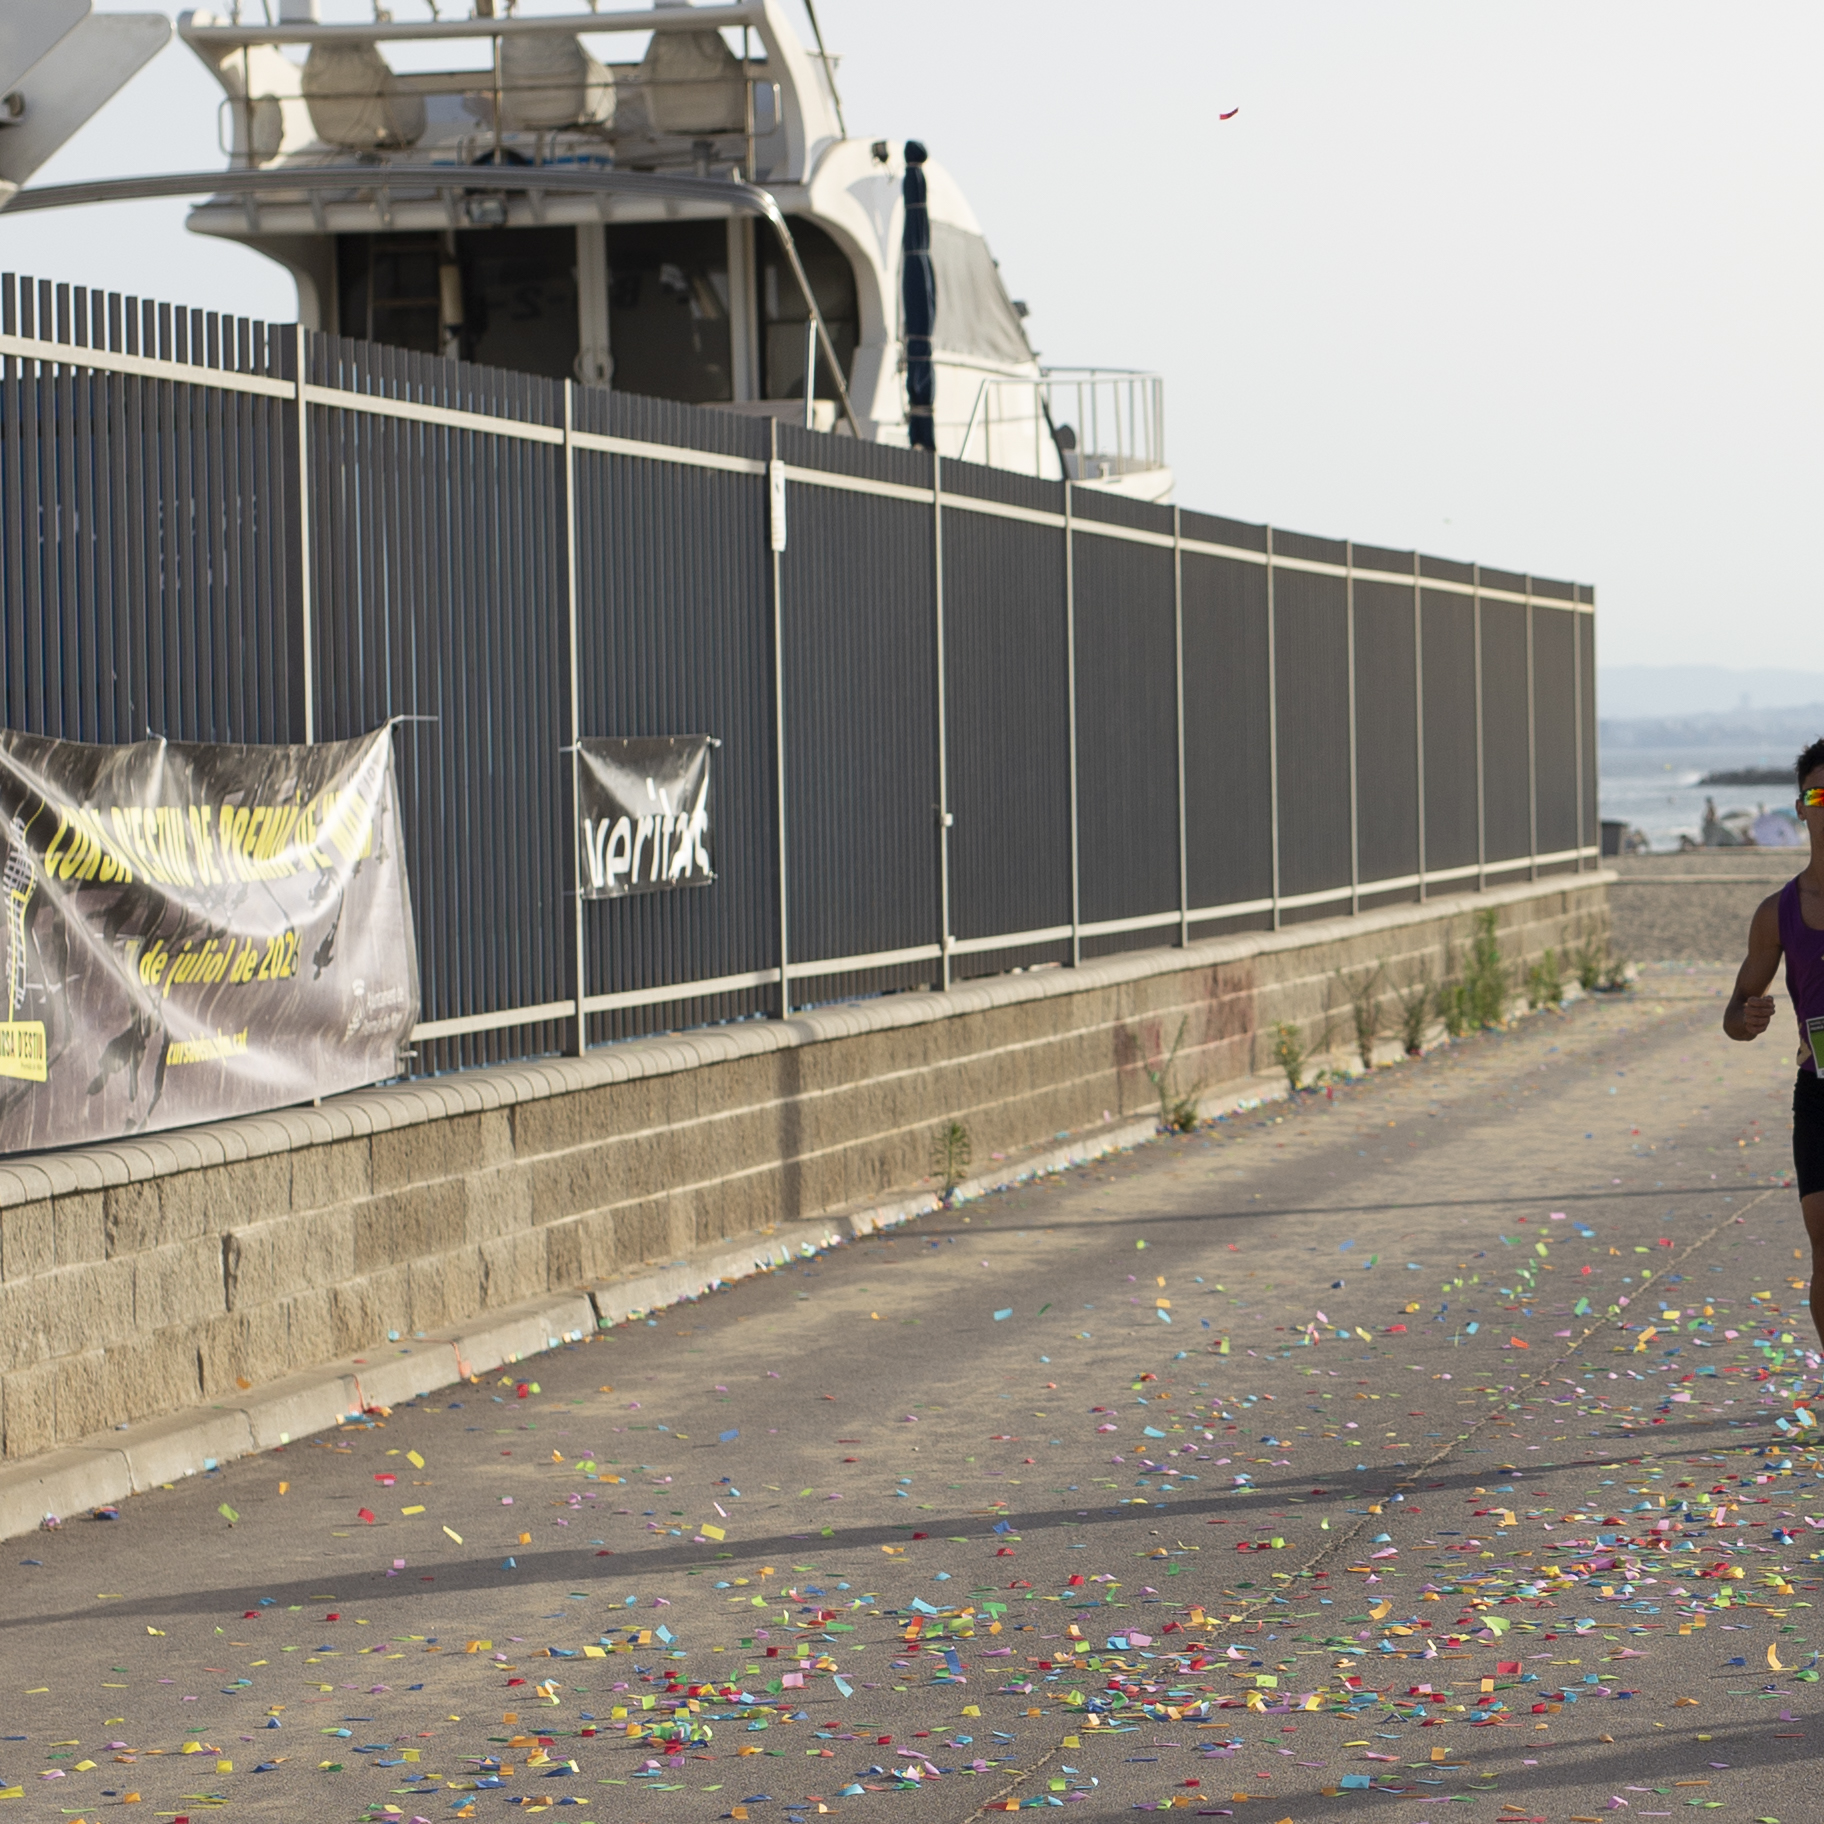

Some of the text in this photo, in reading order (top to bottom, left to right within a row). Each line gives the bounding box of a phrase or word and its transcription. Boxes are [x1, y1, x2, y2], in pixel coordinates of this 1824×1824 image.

[189, 805, 223, 887] DE
[139, 939, 169, 986] de
[162, 937, 236, 999] juliol
[229, 936, 258, 984] de
